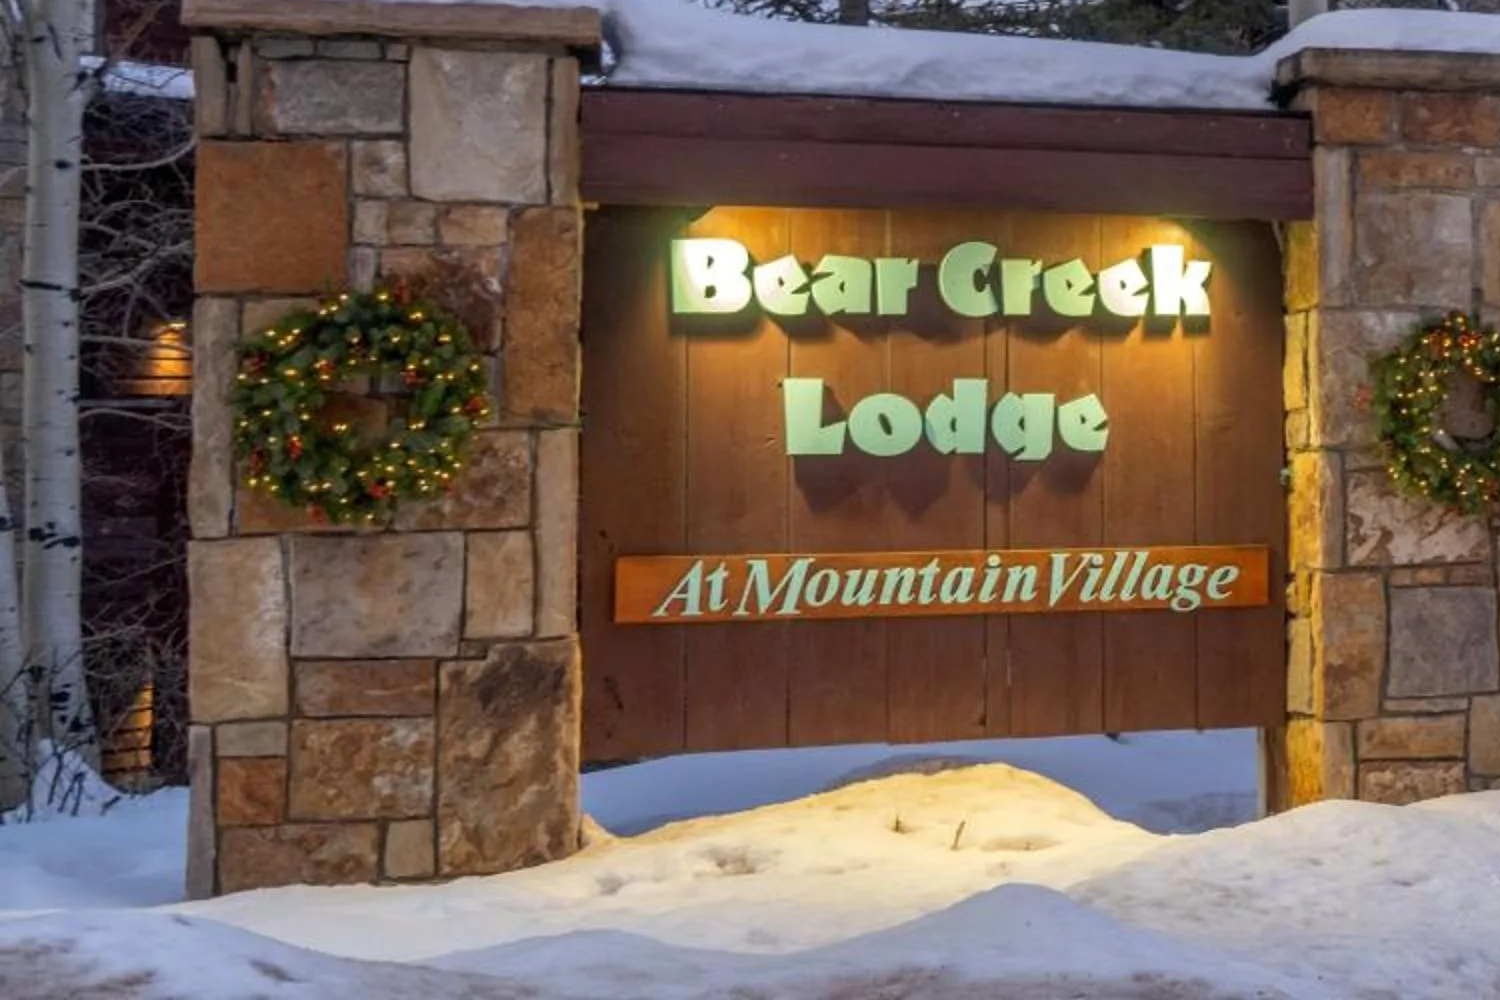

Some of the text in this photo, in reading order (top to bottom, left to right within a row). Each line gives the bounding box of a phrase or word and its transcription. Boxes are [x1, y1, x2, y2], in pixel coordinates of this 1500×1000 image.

[671, 238, 1212, 317] Bear Creek
[783, 378, 1109, 461] Lodge
[653, 551, 1240, 617] At Mountain Village
